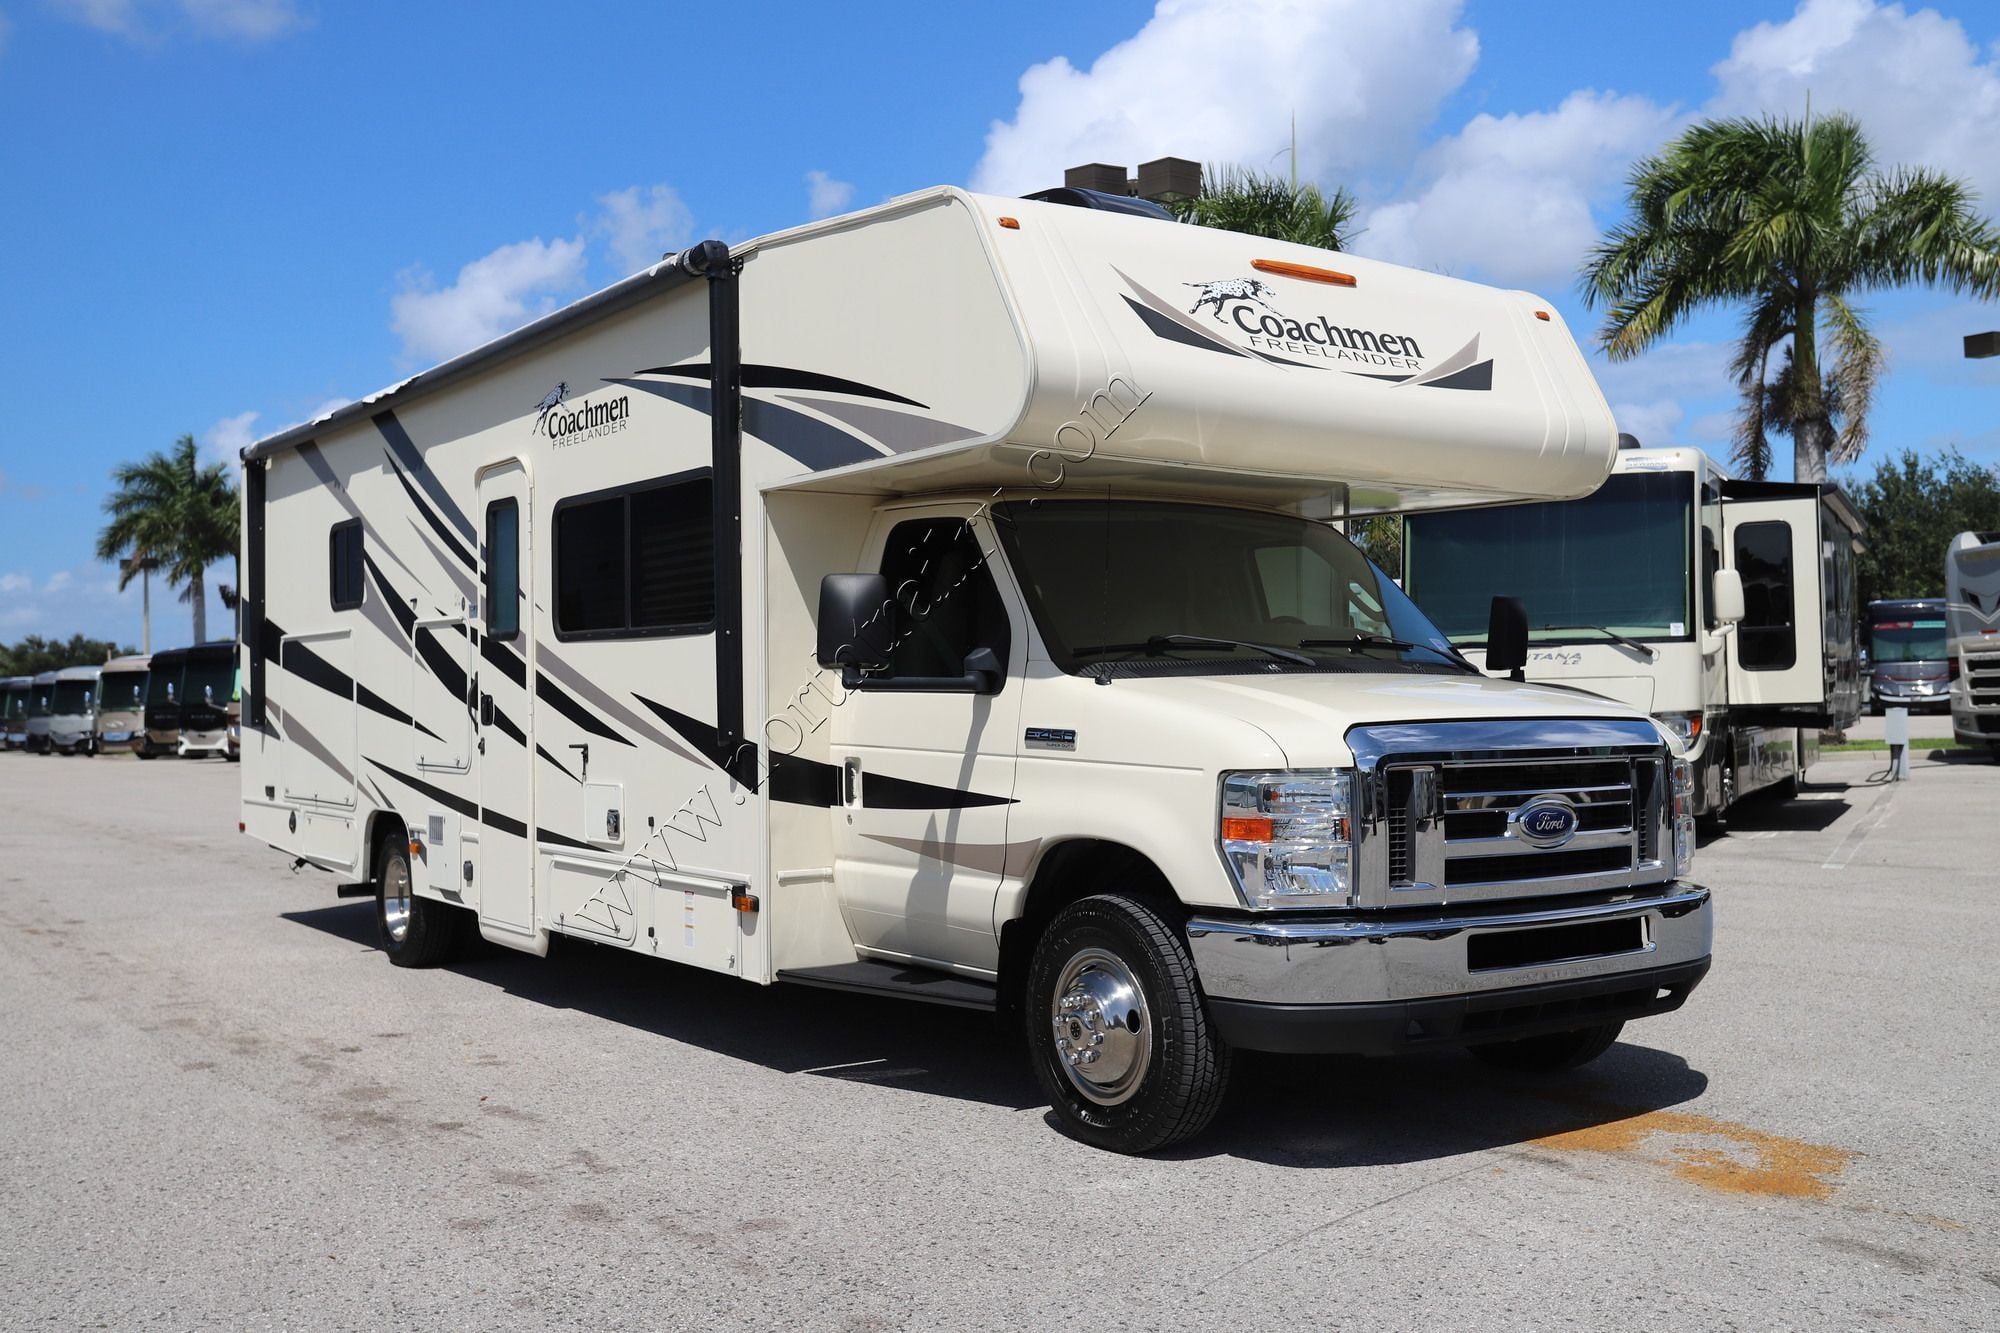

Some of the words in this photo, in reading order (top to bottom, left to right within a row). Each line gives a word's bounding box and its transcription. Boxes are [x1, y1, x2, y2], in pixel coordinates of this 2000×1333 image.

[1232, 304, 1425, 359] Coachmen
[1249, 335, 1423, 371] FREELANDER
[548, 395, 630, 439] Coachmen
[552, 419, 627, 450] FREELANDER
[1527, 652, 1582, 661] TANA
[1536, 811, 1566, 831] Ford
